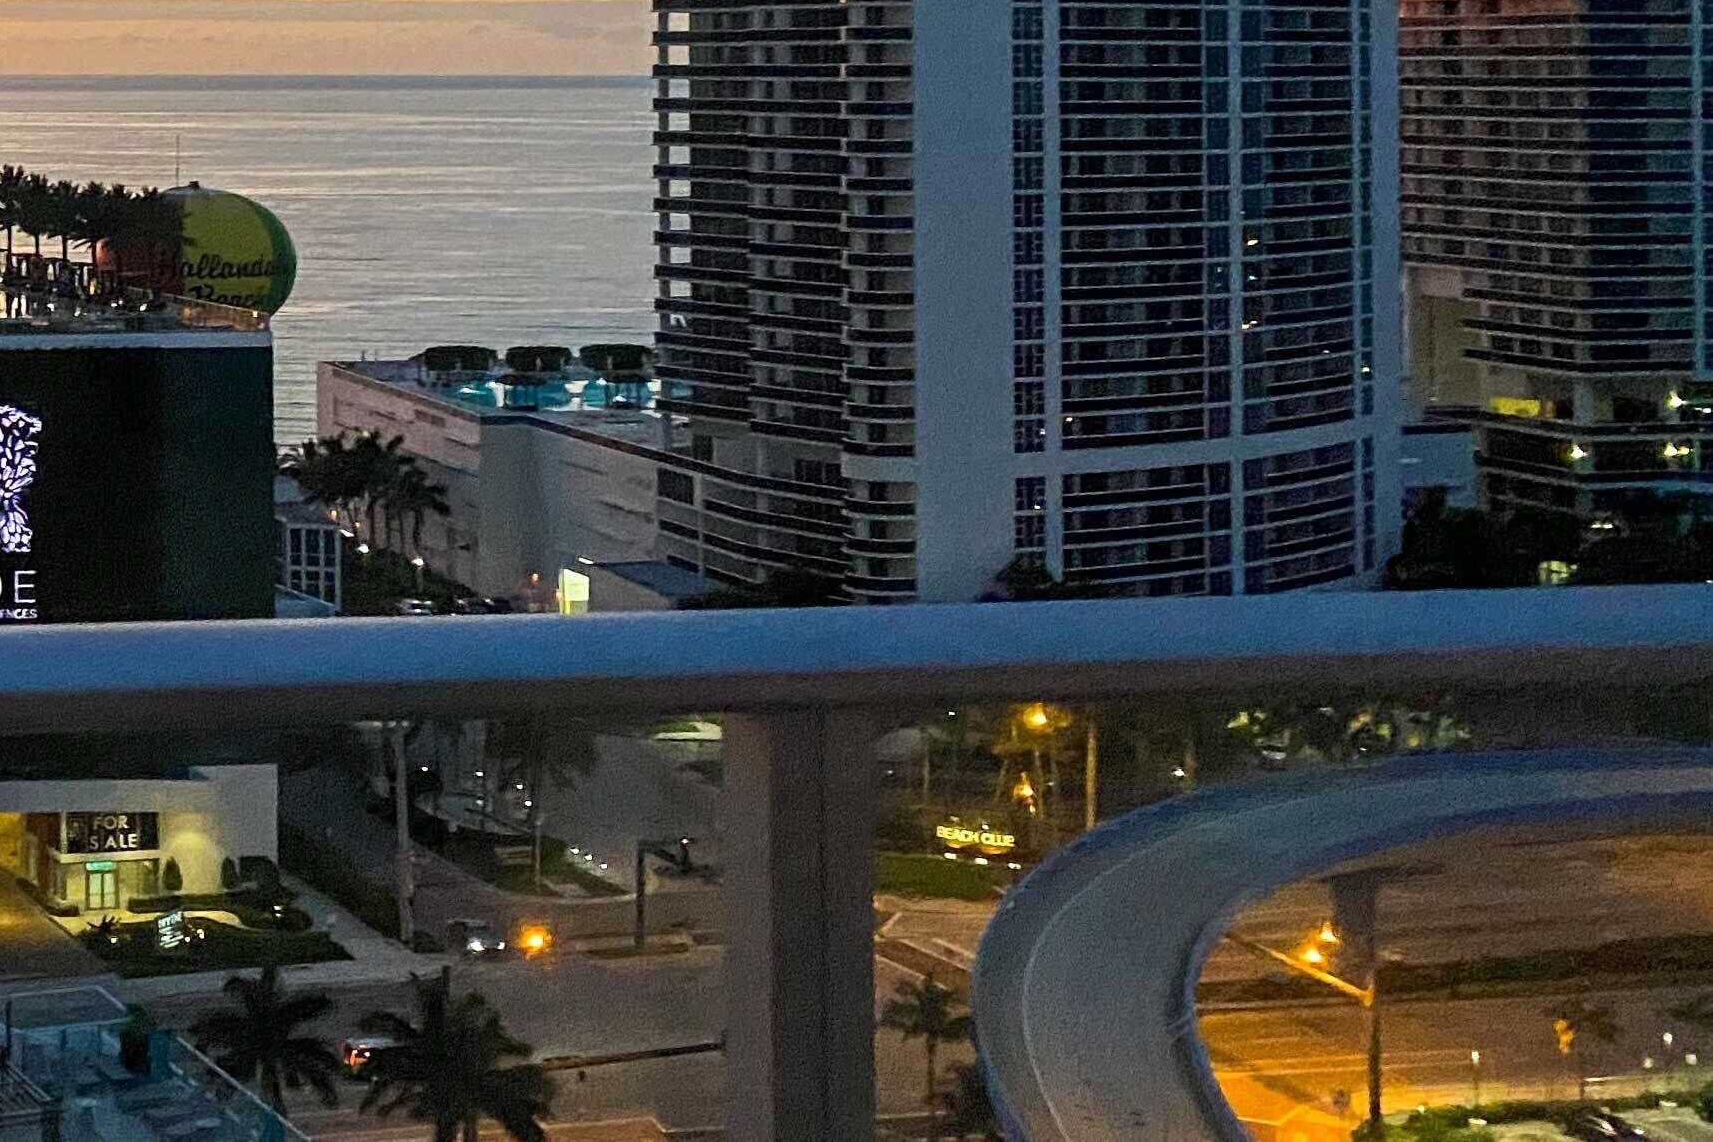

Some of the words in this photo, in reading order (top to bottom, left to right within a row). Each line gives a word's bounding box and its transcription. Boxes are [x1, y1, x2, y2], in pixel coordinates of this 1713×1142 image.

[93, 815, 129, 830] FOR
[89, 833, 138, 850] SALE
[937, 826, 980, 843] BEACH
